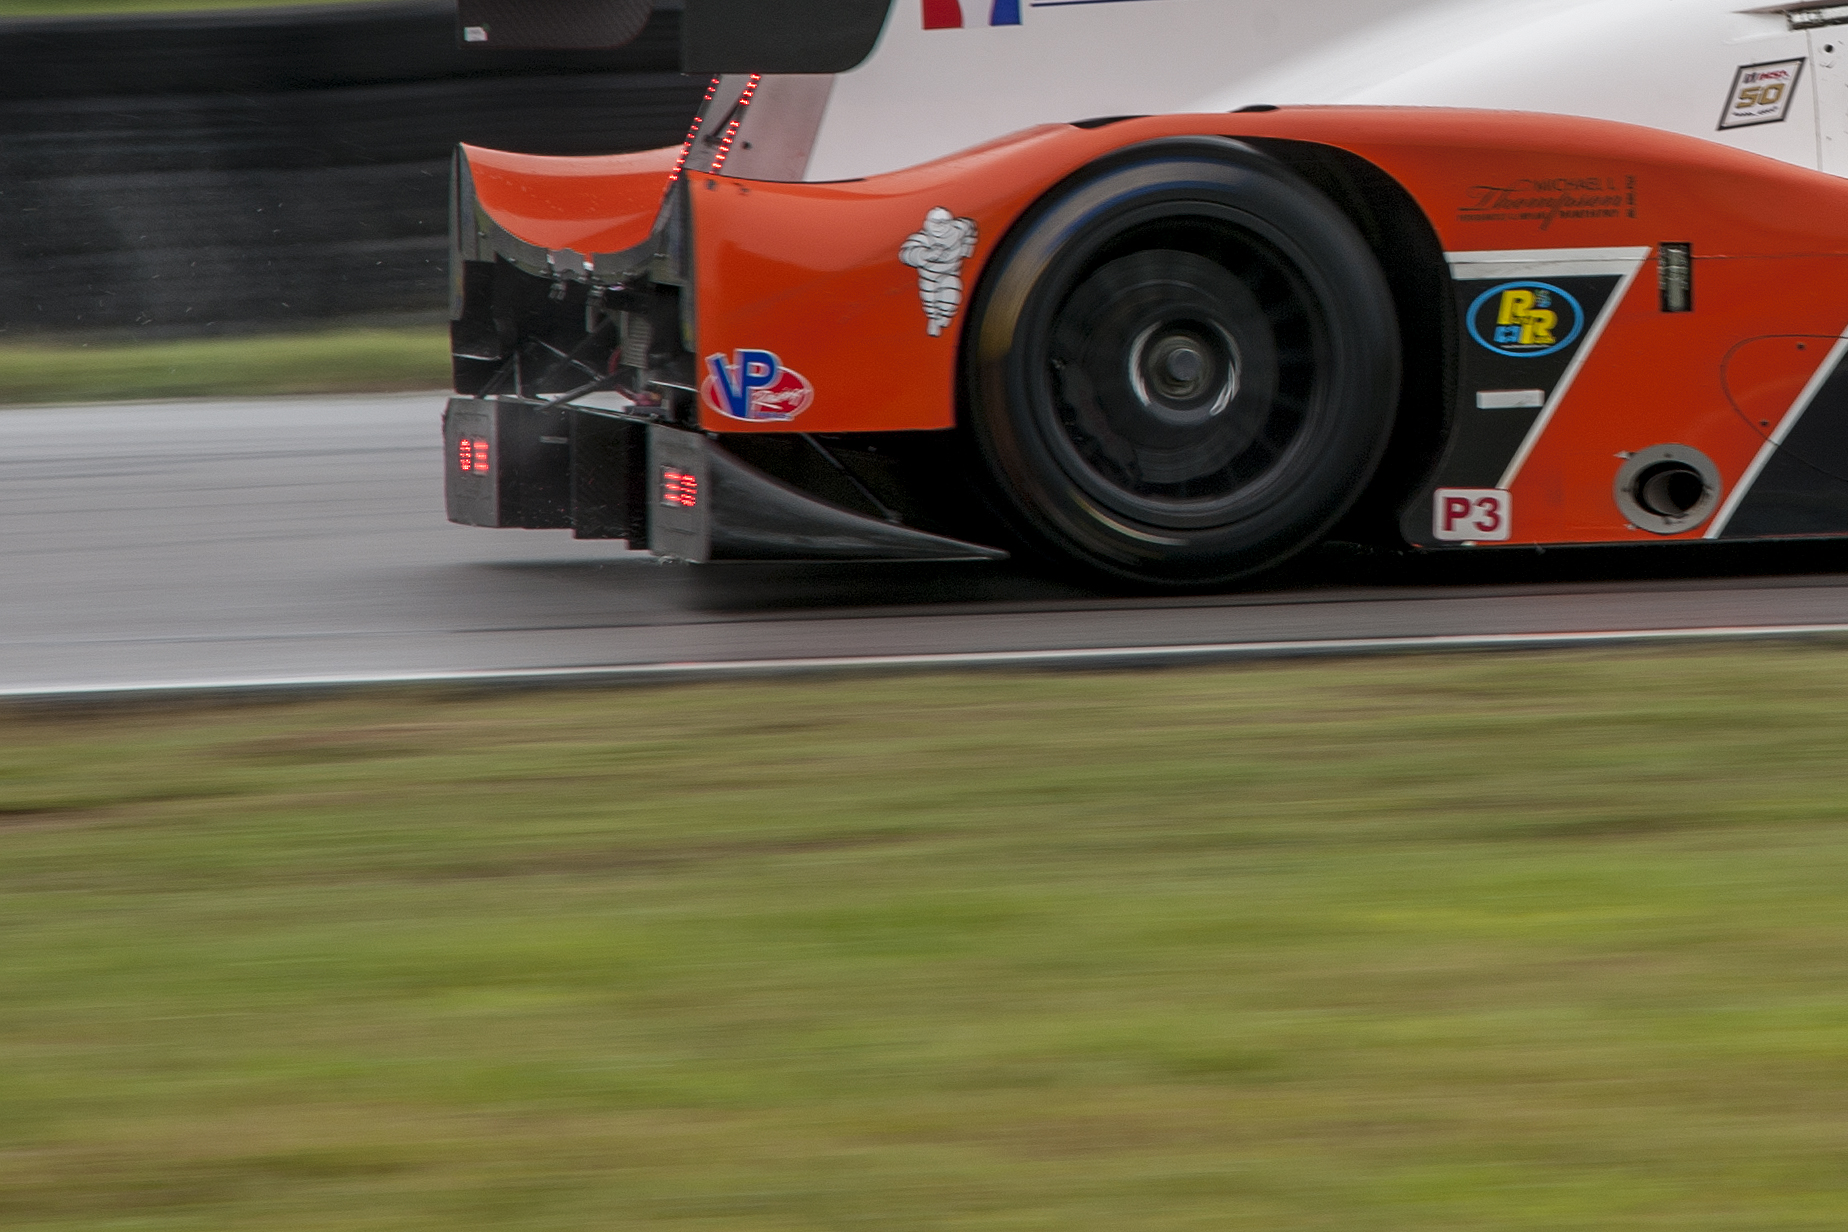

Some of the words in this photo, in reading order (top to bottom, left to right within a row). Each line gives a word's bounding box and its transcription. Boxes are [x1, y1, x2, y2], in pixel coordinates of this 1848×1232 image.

[1734, 83, 1785, 109] 50
[709, 350, 780, 418] VP
[1441, 496, 1501, 533] P3
